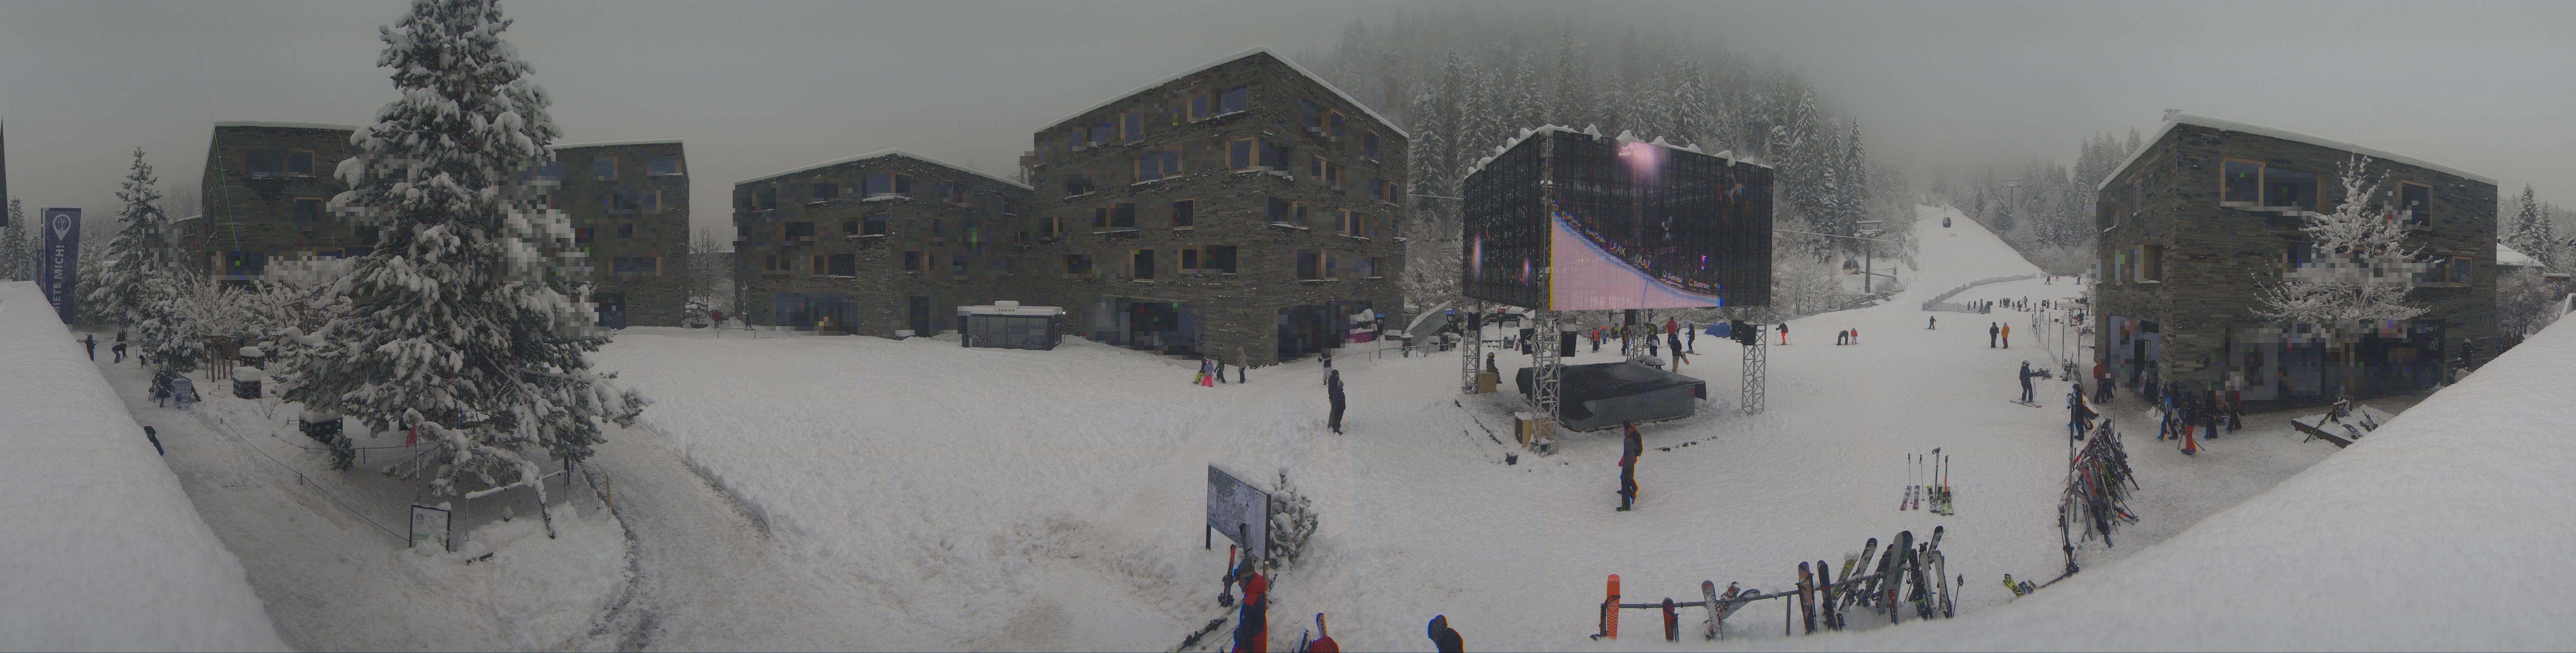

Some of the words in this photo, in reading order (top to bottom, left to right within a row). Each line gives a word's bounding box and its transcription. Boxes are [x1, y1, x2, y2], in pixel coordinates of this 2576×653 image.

[1608, 240, 1626, 256] LAAX
[54, 245, 65, 280] MICH!
[1635, 253, 1651, 271] LAAX
